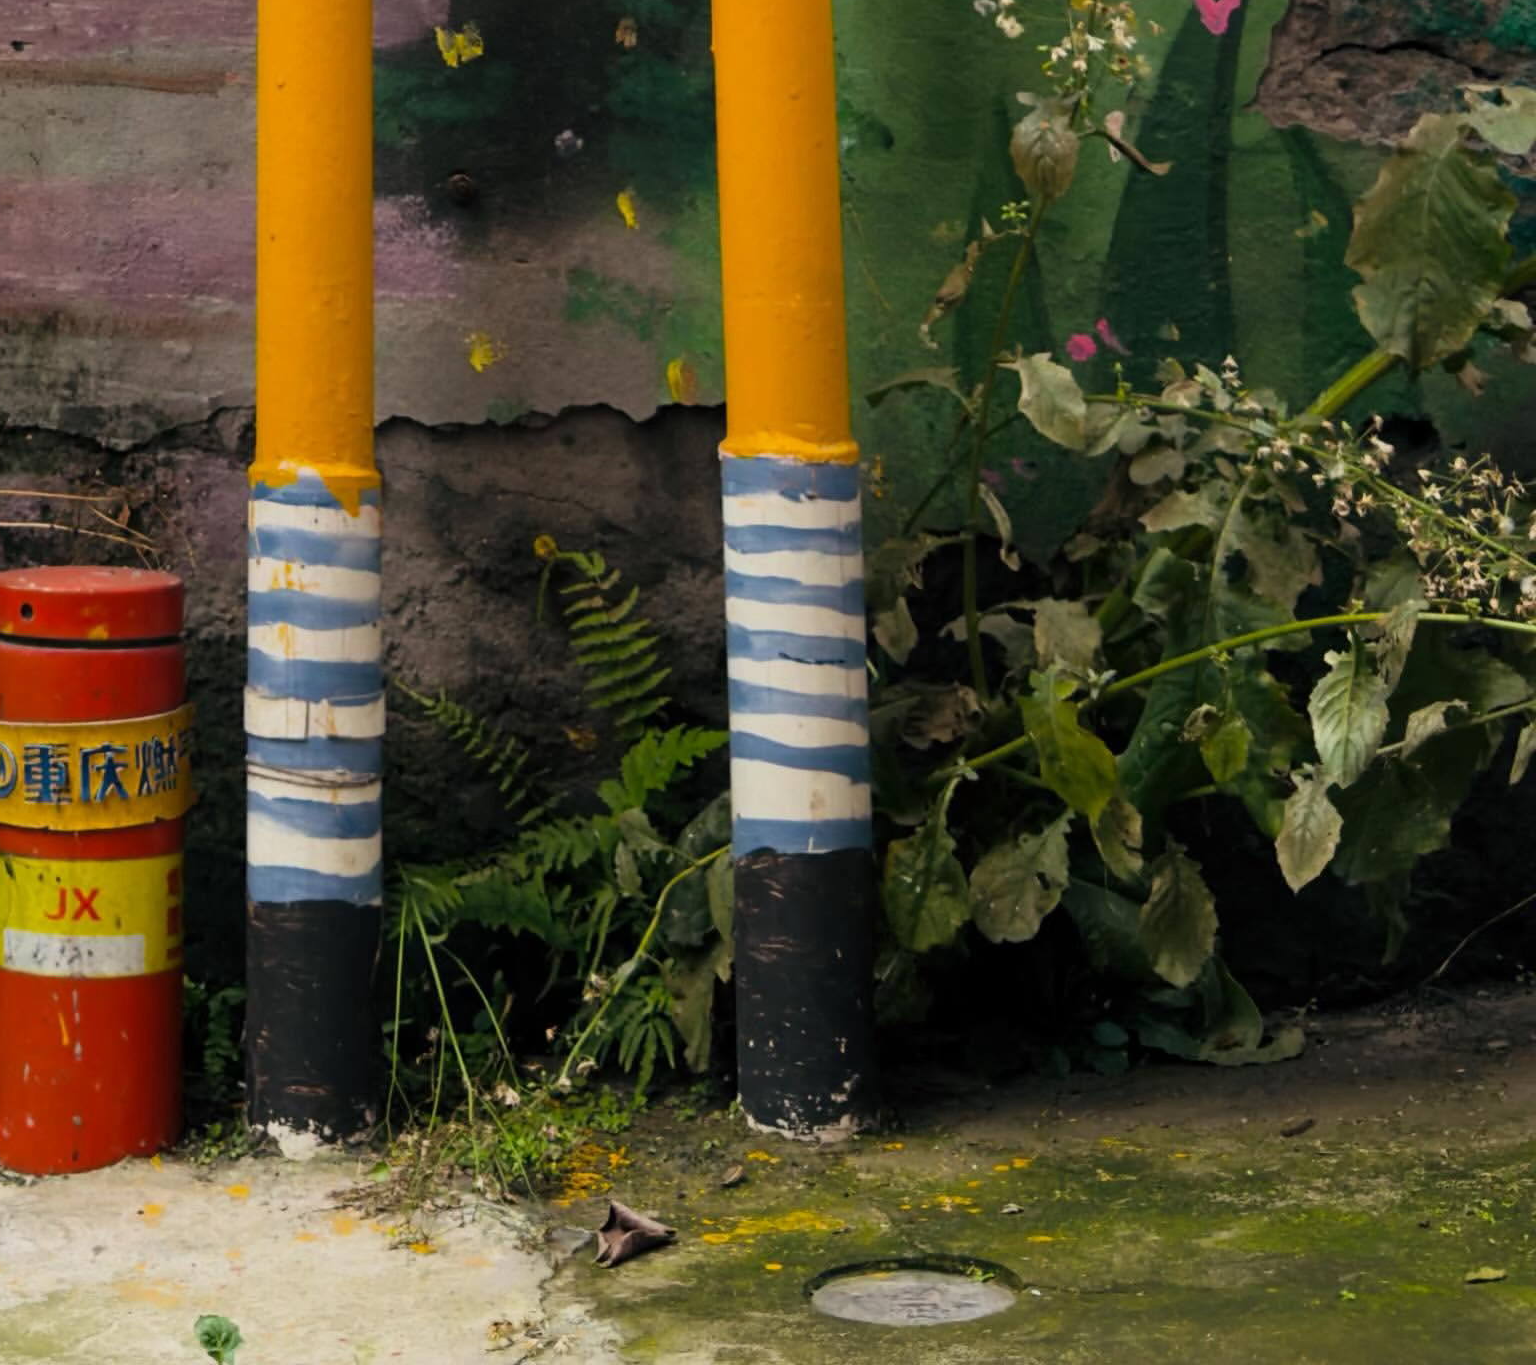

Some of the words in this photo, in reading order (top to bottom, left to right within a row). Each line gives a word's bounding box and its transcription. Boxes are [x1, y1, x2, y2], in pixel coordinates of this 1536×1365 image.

[24, 729, 199, 805] 重庆燃
[44, 888, 102, 921] JX
